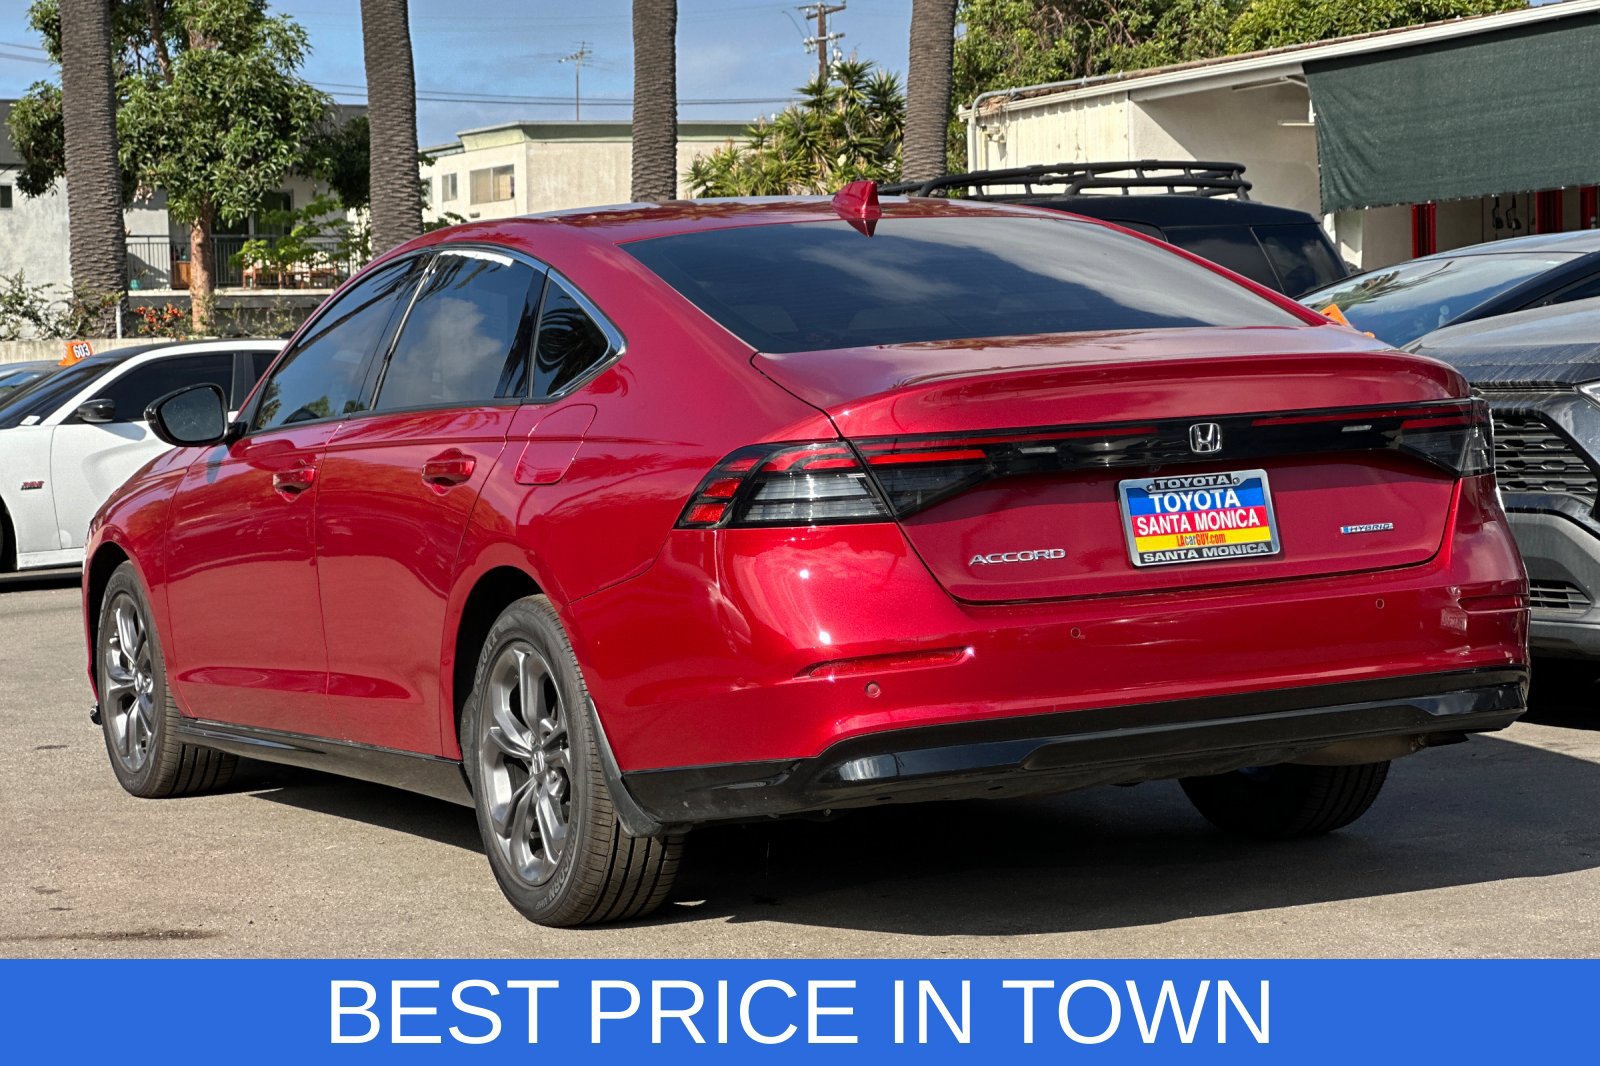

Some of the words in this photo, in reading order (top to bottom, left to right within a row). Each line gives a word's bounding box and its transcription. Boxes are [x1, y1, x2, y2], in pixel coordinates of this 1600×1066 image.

[73, 342, 91, 359] 603
[1156, 475, 1231, 490] TOYOTA
[1148, 488, 1241, 513] TOYOTA
[1137, 513, 1191, 536] SANTA
[1194, 508, 1260, 530] MONICA
[1350, 522, 1391, 533] HYBRID
[1176, 532, 1227, 547] LAcarGUY.com
[969, 548, 1066, 566] ACCORD
[1143, 549, 1199, 563] SANTA
[1203, 543, 1269, 558] MONICA
